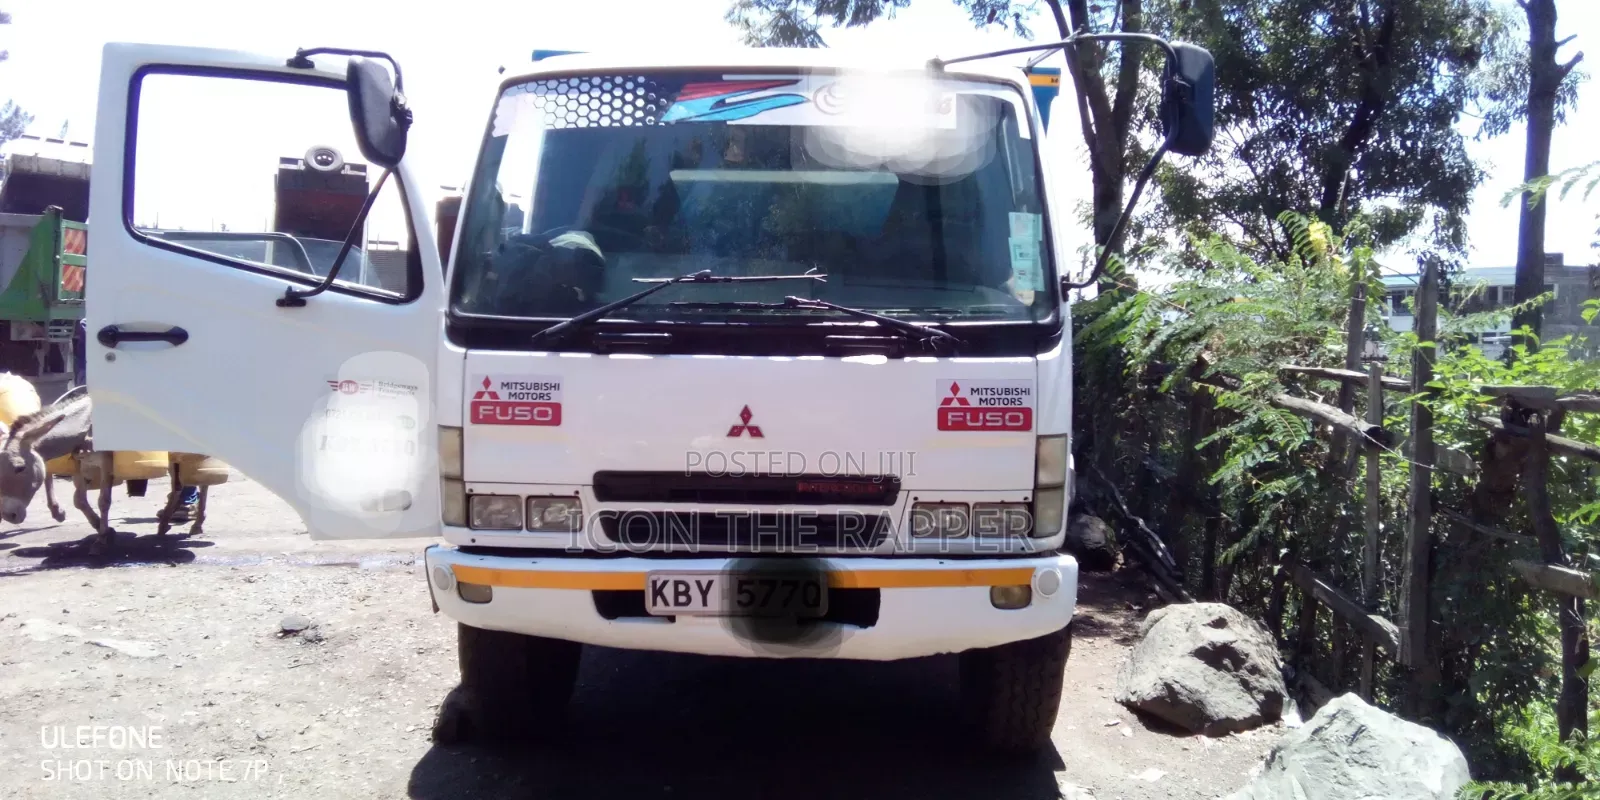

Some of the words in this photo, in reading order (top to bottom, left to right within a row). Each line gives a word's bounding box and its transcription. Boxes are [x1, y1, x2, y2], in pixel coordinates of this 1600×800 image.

[501, 382, 560, 391] MITSUBISHI
[970, 387, 1031, 396] MITSUBISHI
[508, 392, 552, 401] MOTORS
[978, 397, 1023, 406] MOTORS
[479, 406, 552, 421] FUSO
[947, 412, 1024, 426] FUSO
[651, 579, 714, 607] KBY
